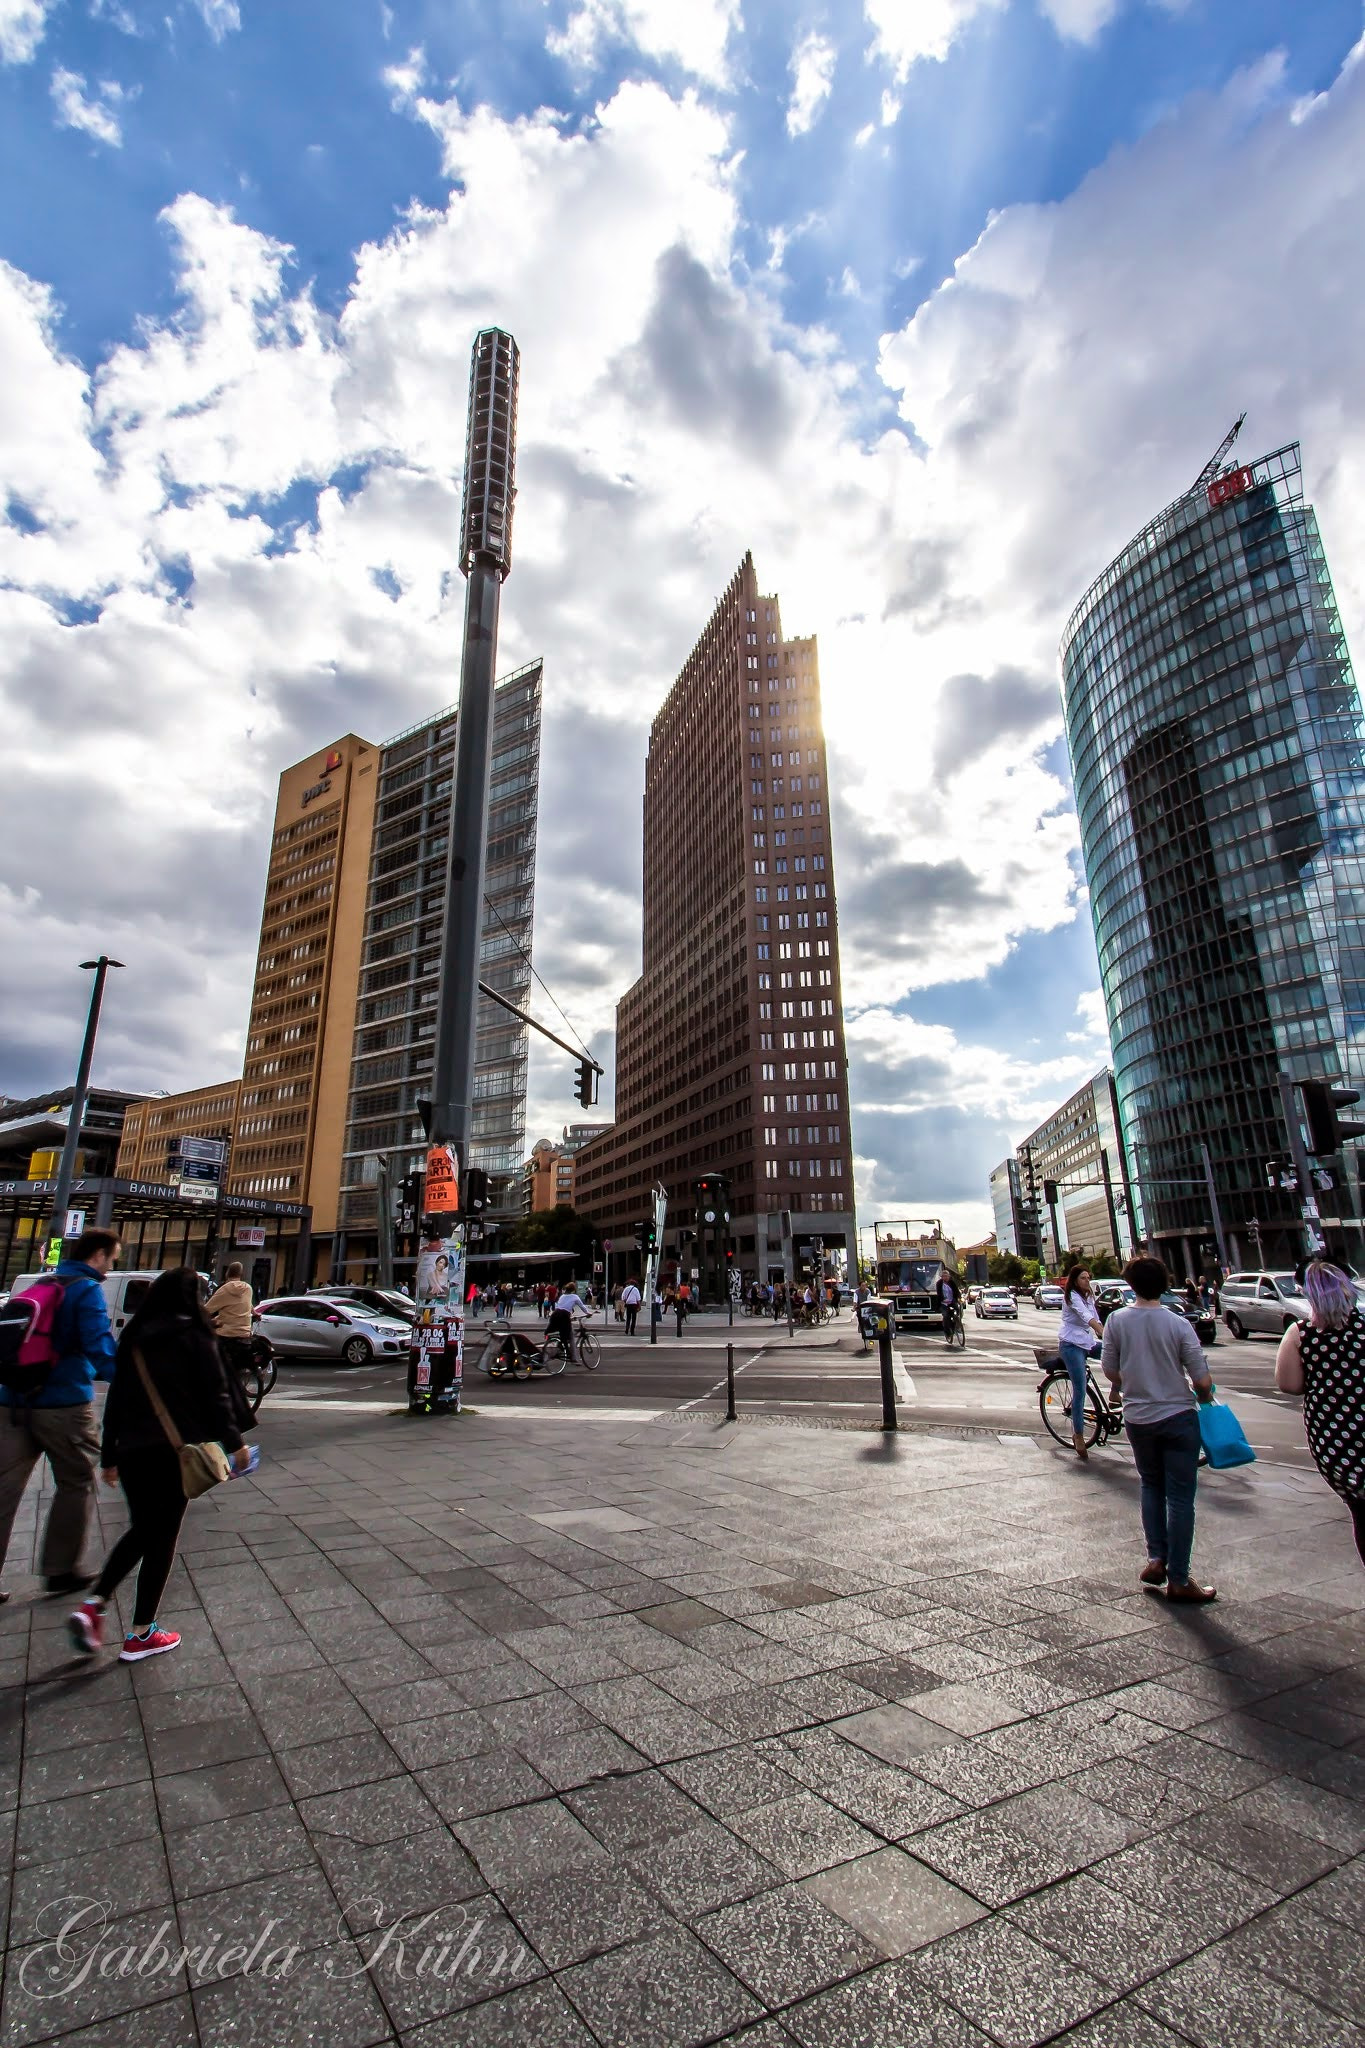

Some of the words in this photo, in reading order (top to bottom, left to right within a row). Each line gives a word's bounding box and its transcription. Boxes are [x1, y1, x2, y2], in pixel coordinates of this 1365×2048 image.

[1211, 468, 1249, 504] DB
[301, 779, 332, 808] pwc
[32, 1180, 86, 1192] PLZ
[129, 1182, 176, 1198] BAHNH
[225, 1195, 267, 1210] SDAMER
[275, 1203, 304, 1215] PLATZ
[422, 1328, 432, 1337] 28
[433, 1328, 443, 1337] 06
